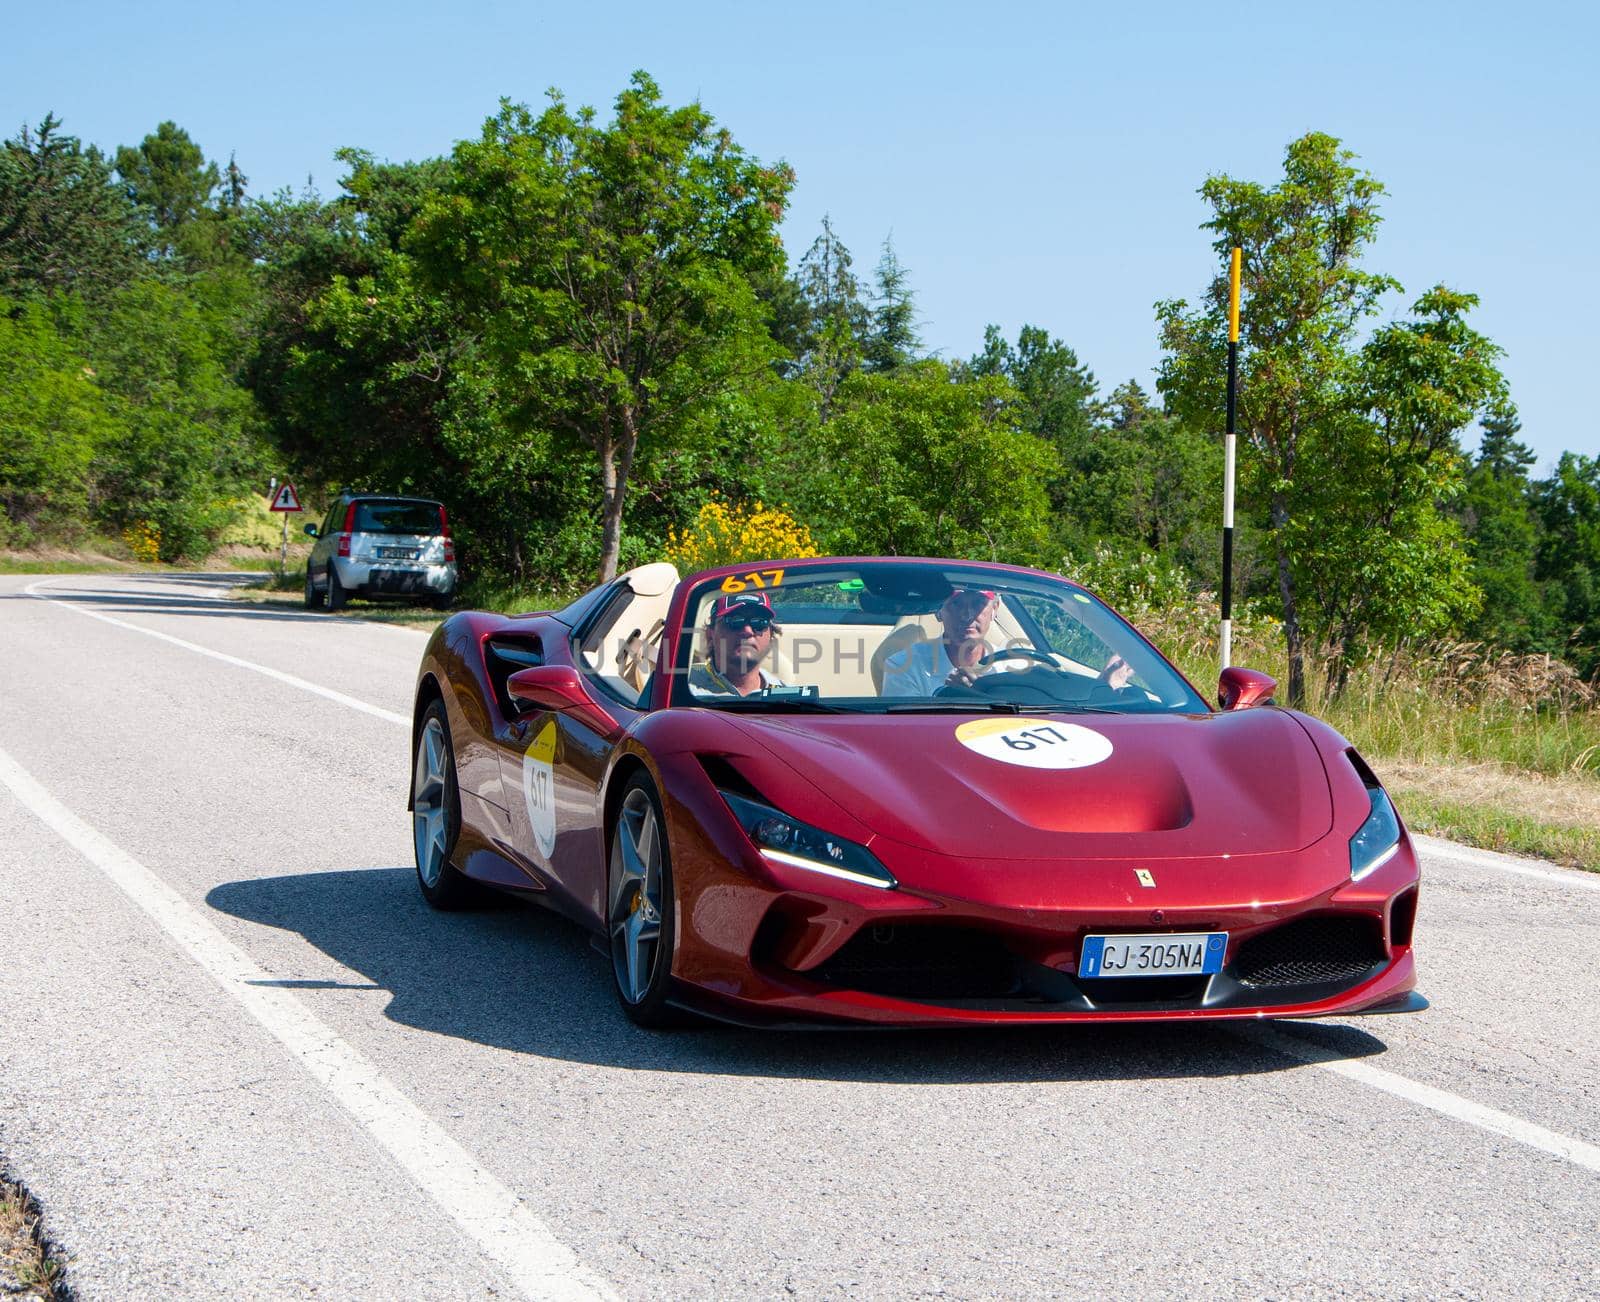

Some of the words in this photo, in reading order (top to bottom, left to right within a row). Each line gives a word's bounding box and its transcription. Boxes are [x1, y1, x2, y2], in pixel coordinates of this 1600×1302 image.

[721, 569, 784, 593] 617
[1001, 727, 1068, 750] 617
[530, 767, 547, 811] 617
